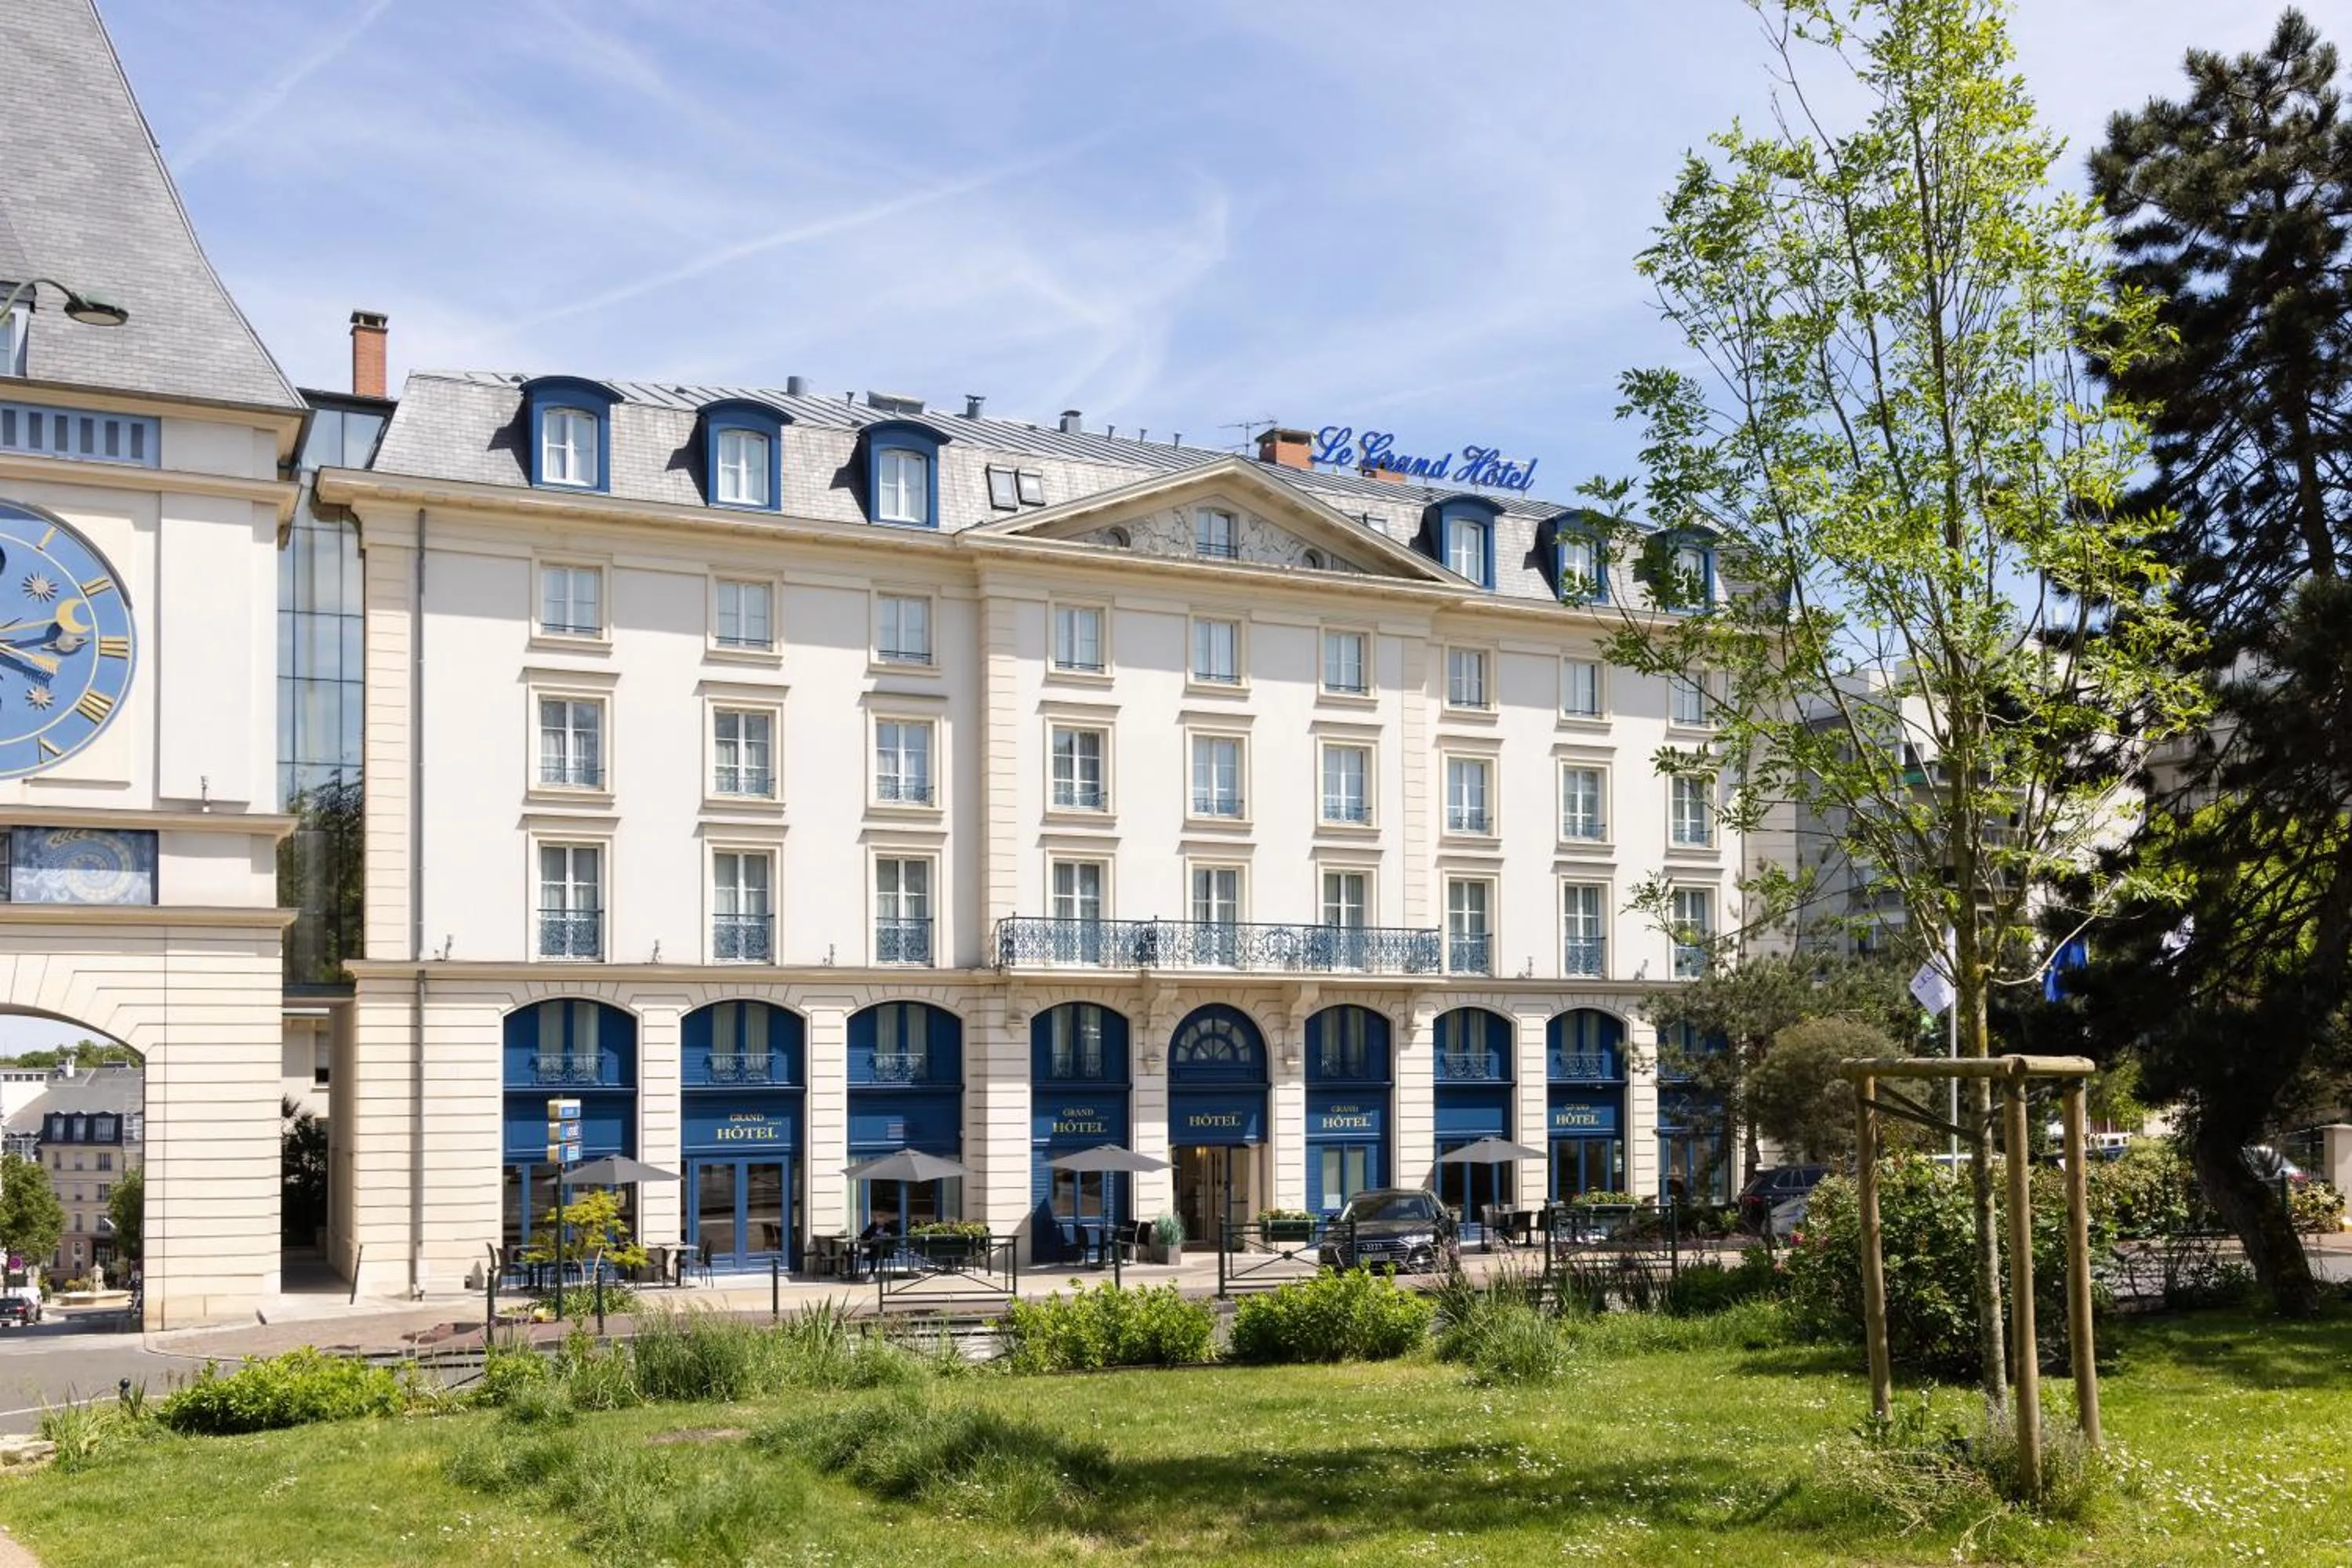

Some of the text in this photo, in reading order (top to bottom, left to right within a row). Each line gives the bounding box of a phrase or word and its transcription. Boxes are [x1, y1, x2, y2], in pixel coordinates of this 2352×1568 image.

[1308, 426, 1537, 491] Le Grand Hôtel
[730, 1112, 764, 1122] GRAND
[1062, 1108, 1094, 1116] GRAND
[1555, 1112, 1599, 1126] HÔTEL
[1053, 1119, 1107, 1133] HÔTEL
[1189, 1112, 1242, 1127] HÔTEL
[1323, 1113, 1372, 1128] HÔTEL
[717, 1124, 779, 1140] HÔTEL
